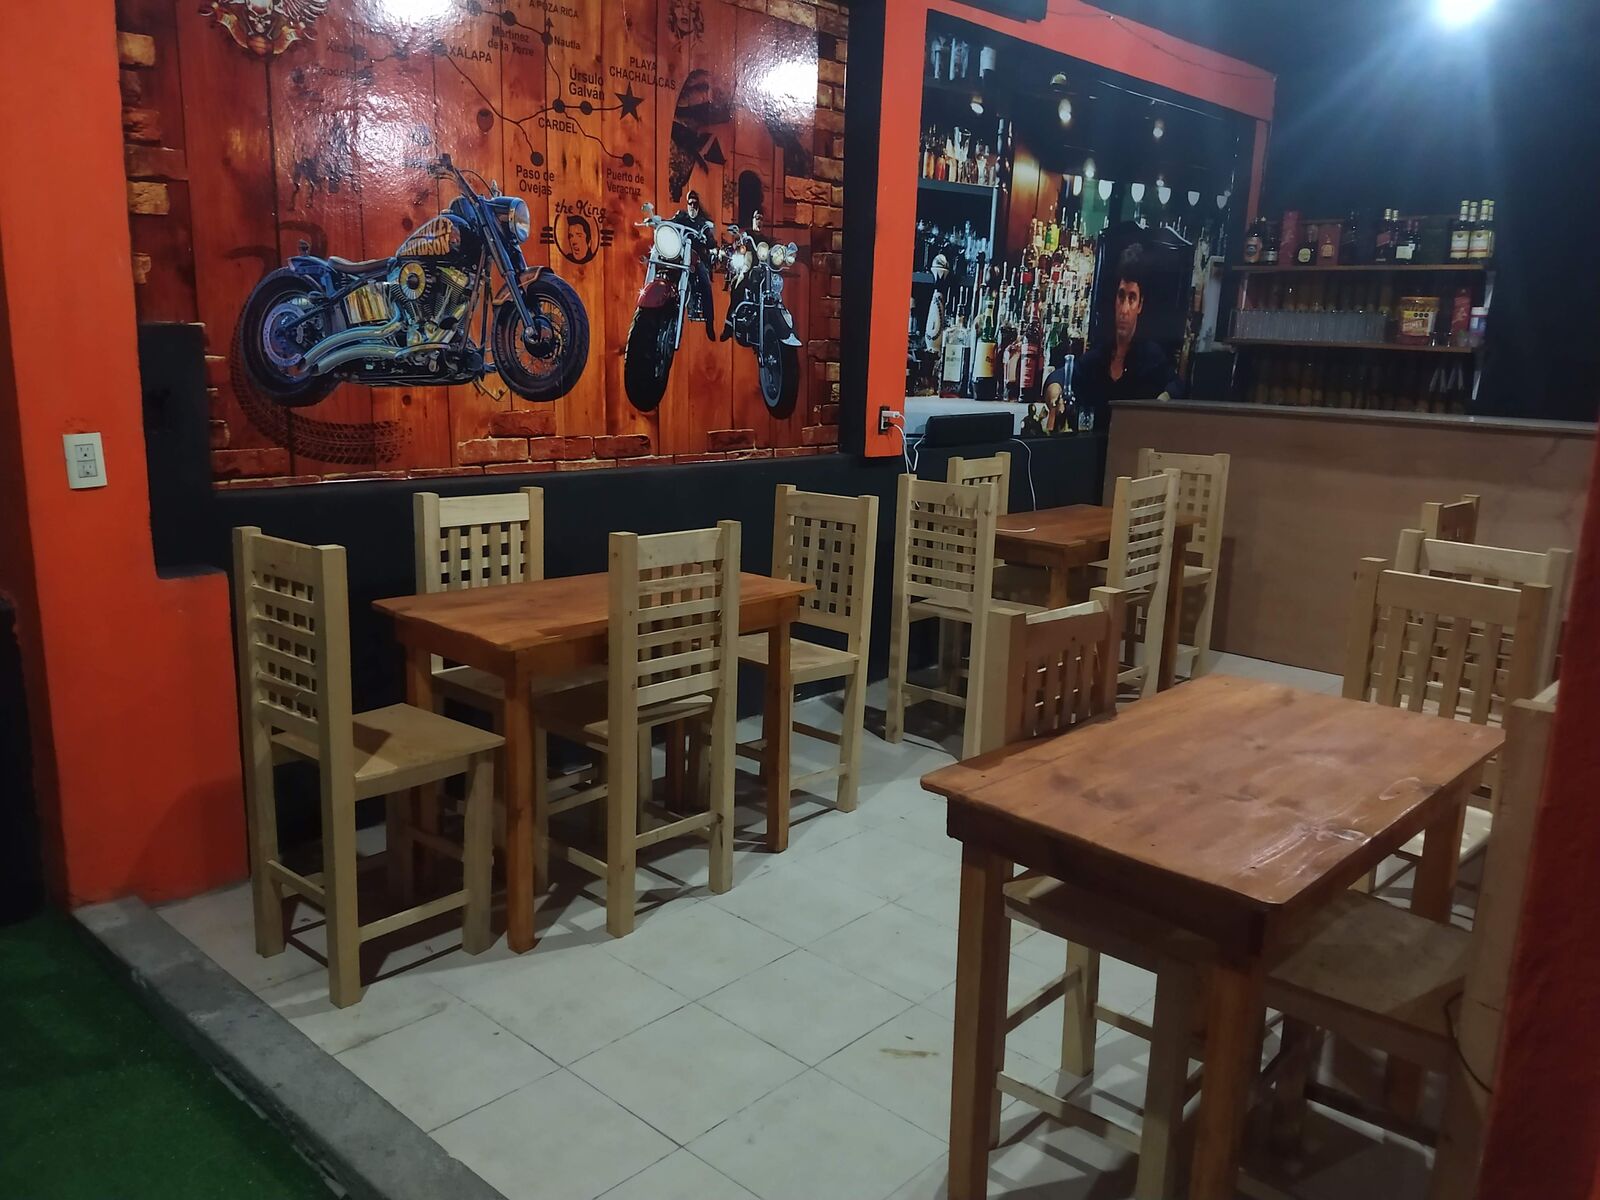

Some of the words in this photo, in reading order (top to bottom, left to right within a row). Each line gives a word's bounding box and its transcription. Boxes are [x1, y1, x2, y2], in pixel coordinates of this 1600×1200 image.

[560, 5, 579, 18] RICA
[553, 35, 581, 50] Nautla
[449, 45, 493, 63] XALAPA
[629, 56, 657, 71] PLAYA
[569, 64, 604, 86] Úrsulo
[609, 65, 676, 90] CHACHALACAS
[568, 82, 605, 101] Galván
[537, 117, 578, 135] CARDEL
[516, 164, 541, 180] Paso
[542, 168, 555, 182] de
[606, 168, 632, 182] Puerto
[634, 173, 645, 185] de
[519, 179, 553, 197] Ovejas
[606, 181, 641, 197] Veracruz
[555, 199, 574, 214] the
[576, 200, 606, 223] King
